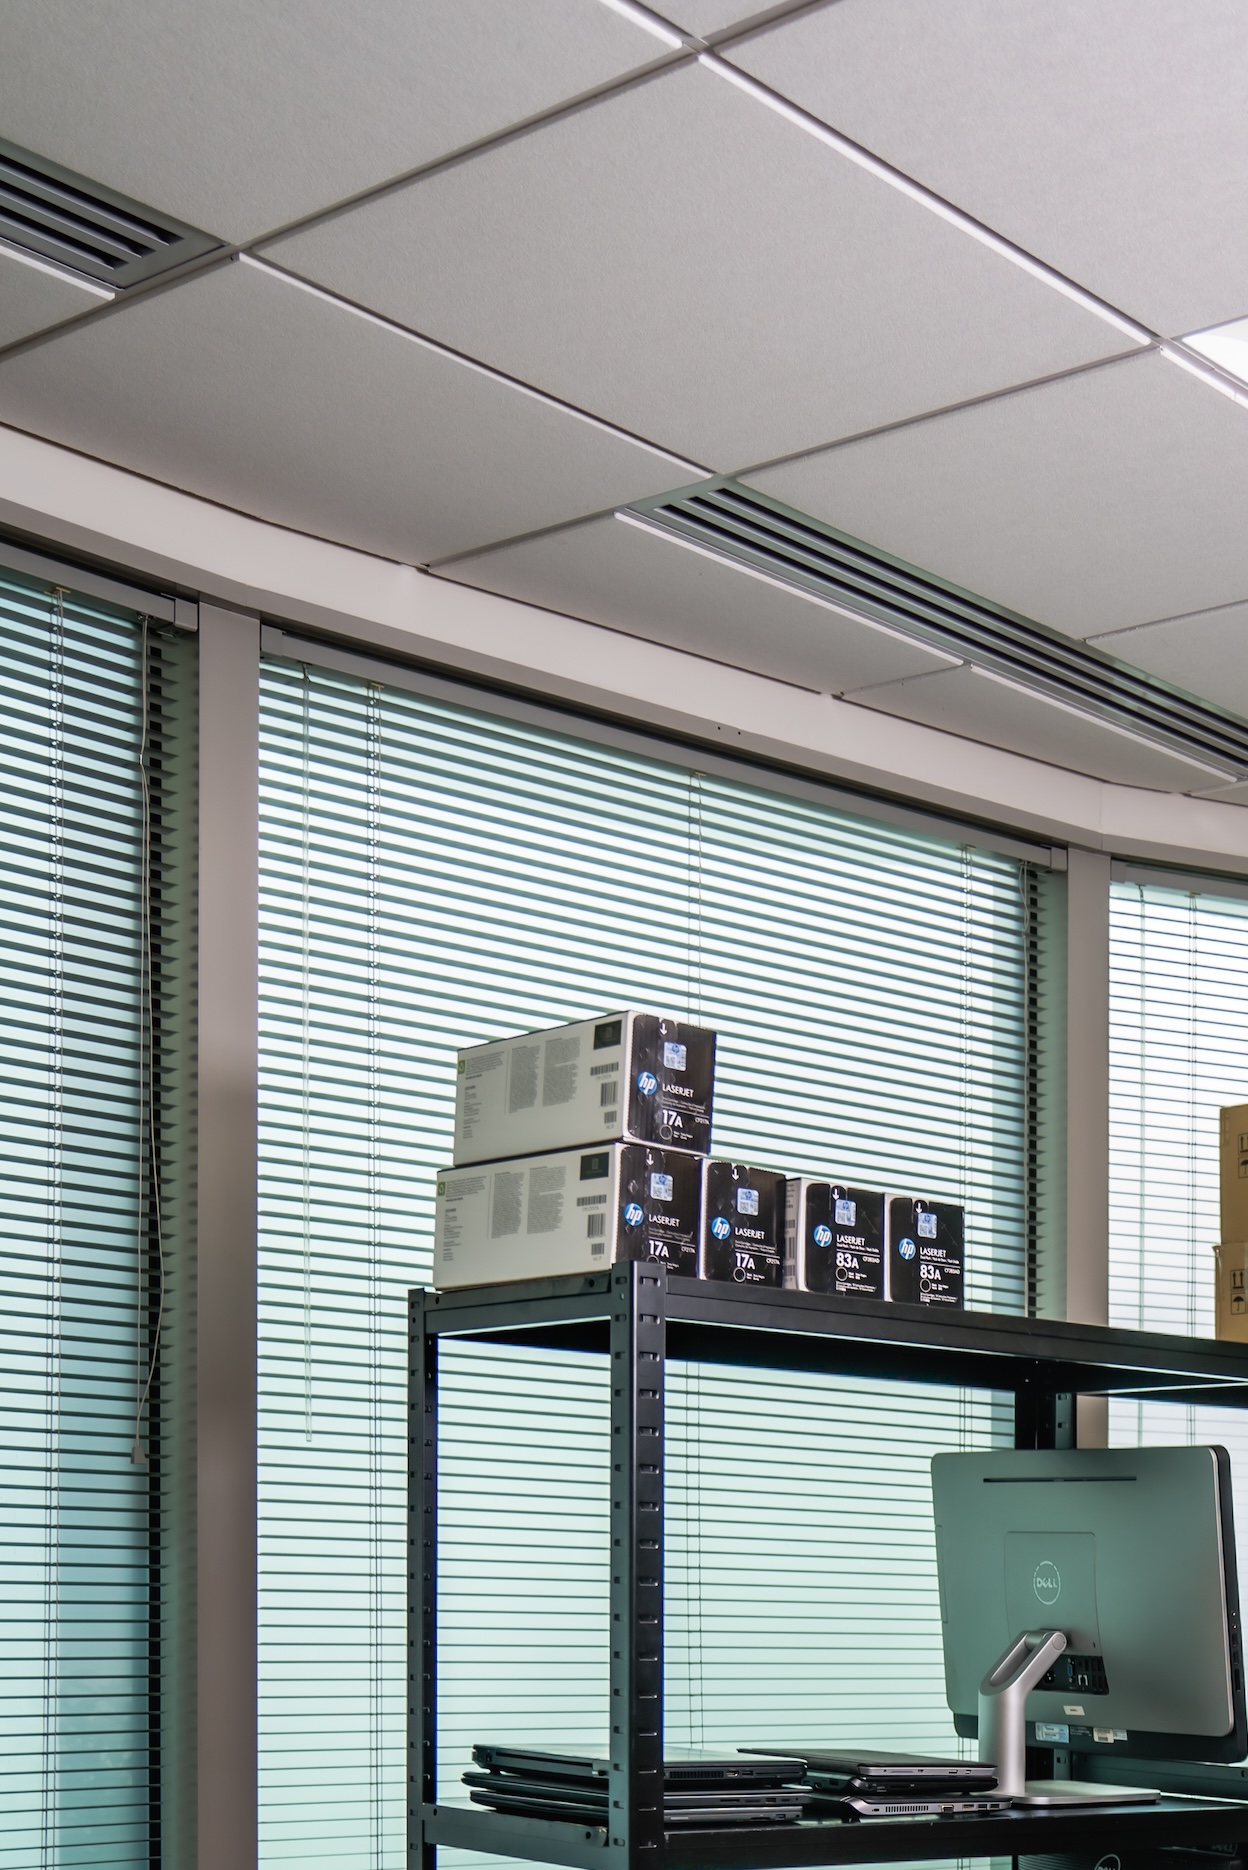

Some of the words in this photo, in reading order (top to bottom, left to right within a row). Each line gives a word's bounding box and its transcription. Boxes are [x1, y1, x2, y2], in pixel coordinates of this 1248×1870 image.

[639, 1071, 656, 1096] hp
[662, 1083, 694, 1098] LASERJET
[662, 1109, 683, 1128] 17A
[625, 1203, 643, 1226] hp
[649, 1214, 680, 1228] LASERJET
[712, 1217, 730, 1240] hp
[735, 1227, 765, 1240] LASERJET
[815, 1225, 831, 1247] hp
[836, 1234, 866, 1246] LASERJET
[649, 1240, 670, 1258] 17A
[901, 1238, 915, 1260] hp
[920, 1246, 946, 1258] LASERJET
[735, 1253, 756, 1270] 17A
[836, 1253, 860, 1270] 83A
[920, 1264, 942, 1281] 83A
[1036, 1576, 1058, 1589] DELL
